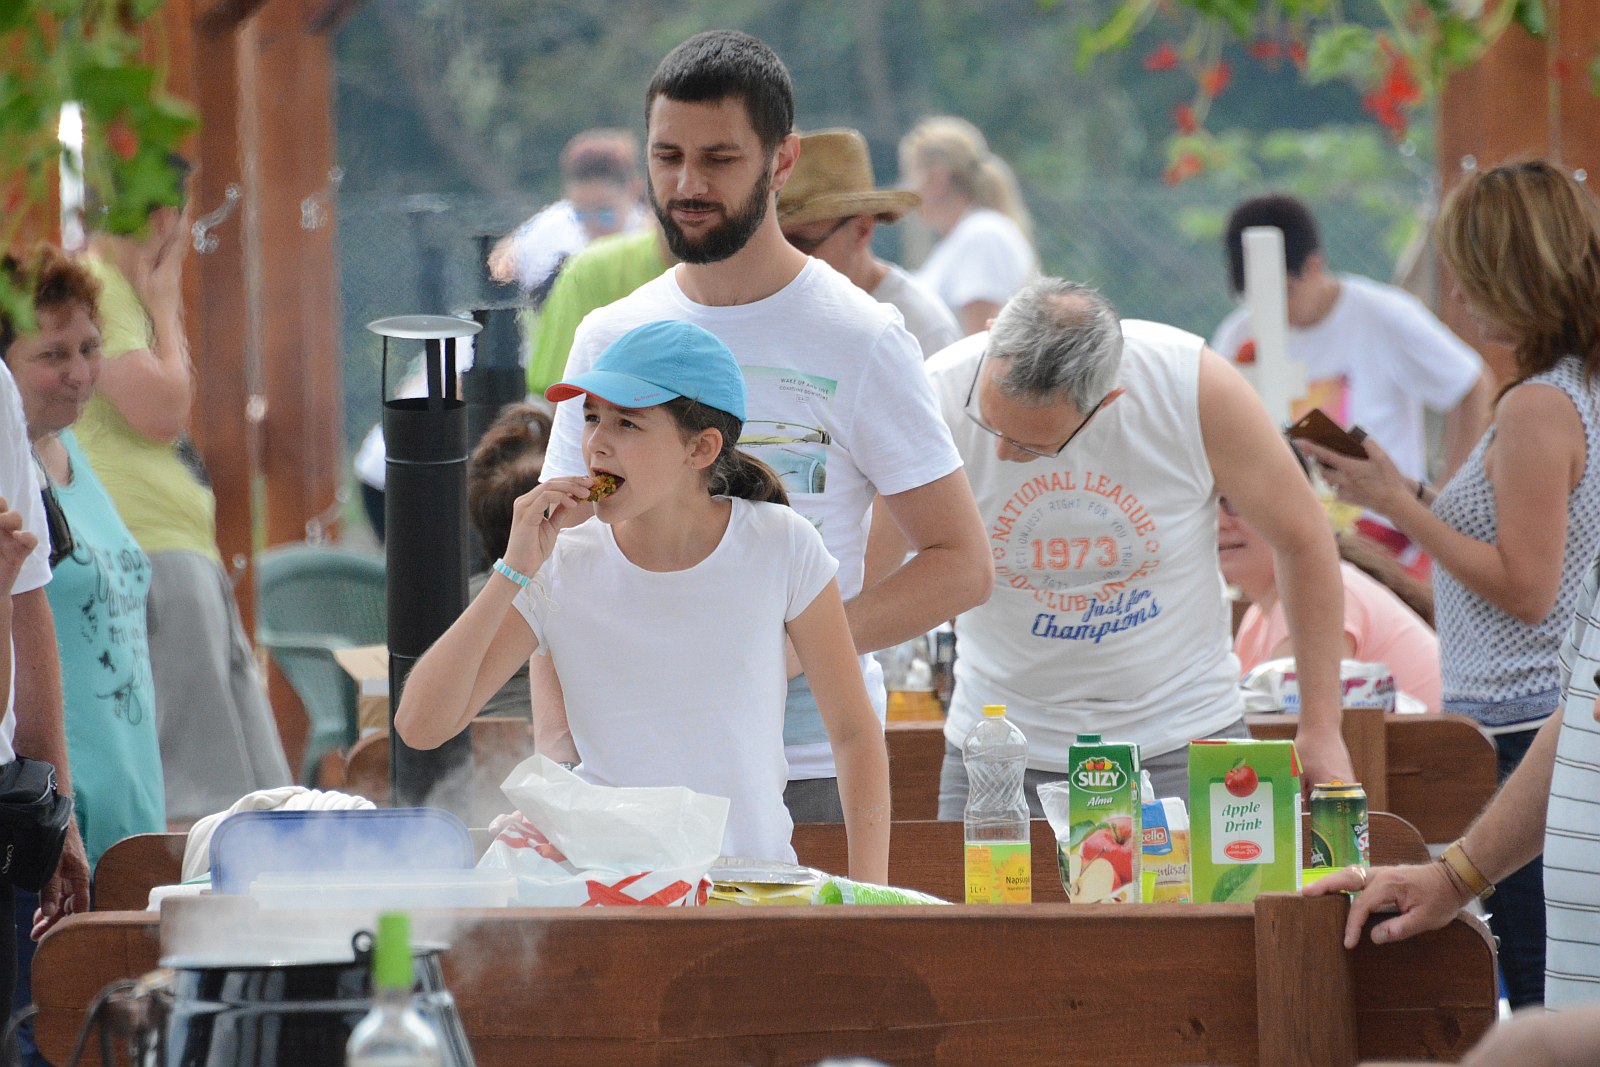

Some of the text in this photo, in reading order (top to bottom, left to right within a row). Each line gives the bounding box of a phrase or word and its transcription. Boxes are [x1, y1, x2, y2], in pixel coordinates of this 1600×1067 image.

[992, 471, 1157, 543] NATIONAL LEAGUE
[1048, 498, 1081, 512] RIGHT
[1087, 501, 1109, 519] FOR
[1031, 536, 1119, 570] 1973
[1081, 588, 1151, 622] Just for
[1032, 599, 1161, 643] Champions
[1078, 772, 1120, 787] SUZY
[1086, 795, 1114, 807] Alma
[1221, 801, 1261, 818] Apple
[1224, 817, 1263, 834] Drink
